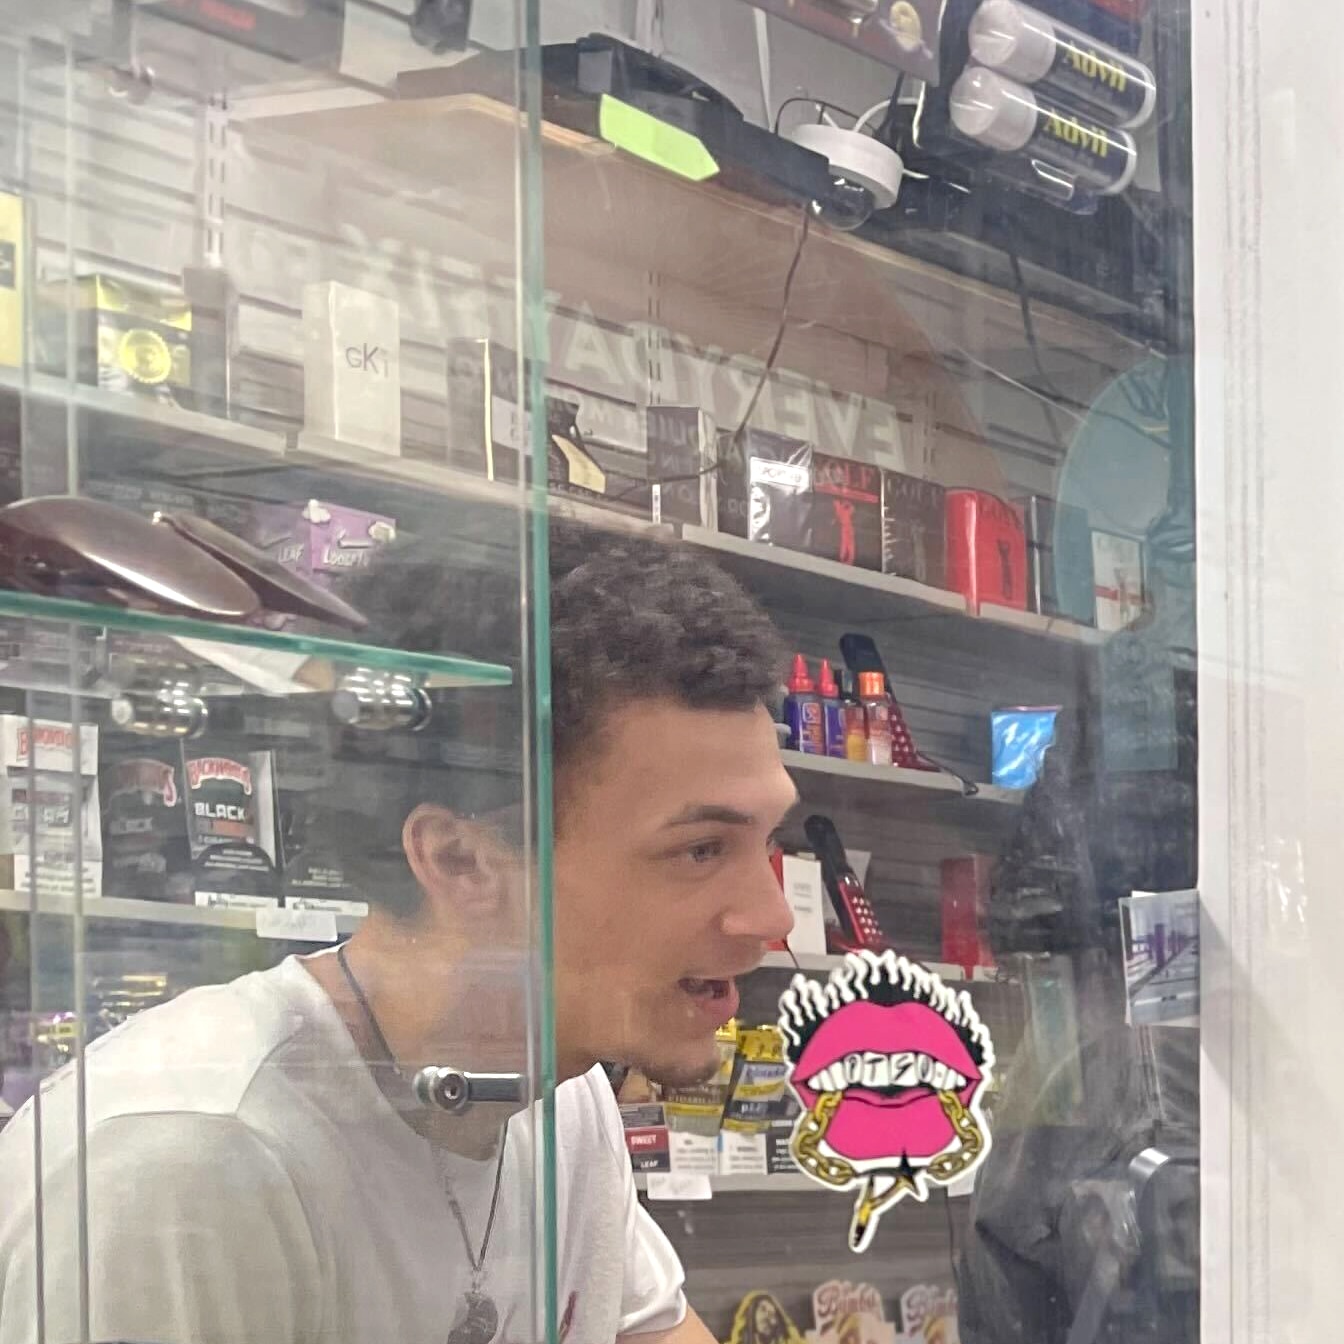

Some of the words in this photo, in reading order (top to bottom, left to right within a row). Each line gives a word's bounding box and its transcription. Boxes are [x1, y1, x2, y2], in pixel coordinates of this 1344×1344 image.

[1064, 42, 1126, 92] Advil
[1043, 107, 1107, 157] Advil
[195, 802, 246, 820] BLACK
